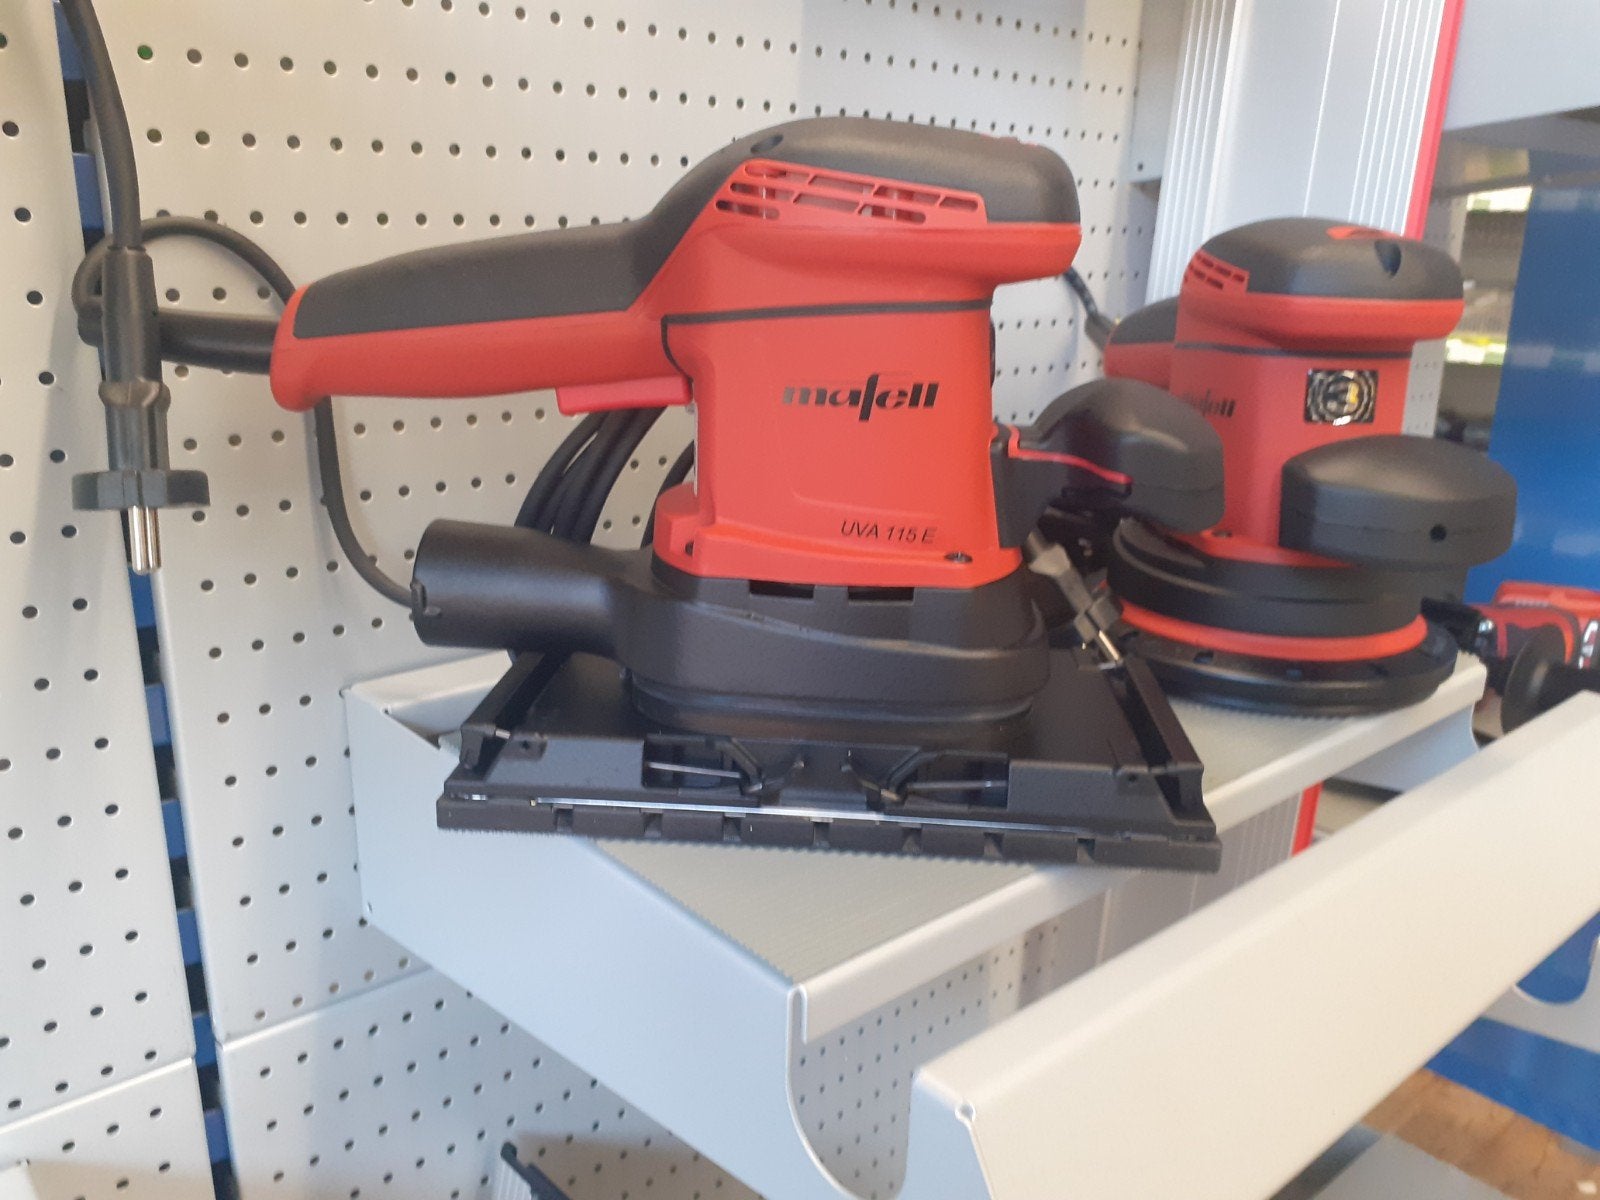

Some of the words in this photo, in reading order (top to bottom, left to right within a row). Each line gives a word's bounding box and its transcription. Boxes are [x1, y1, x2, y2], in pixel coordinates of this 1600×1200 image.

[783, 373, 939, 421] mafell
[841, 520, 878, 538] UVA
[887, 526, 917, 543] 115
[921, 527, 937, 544] E
